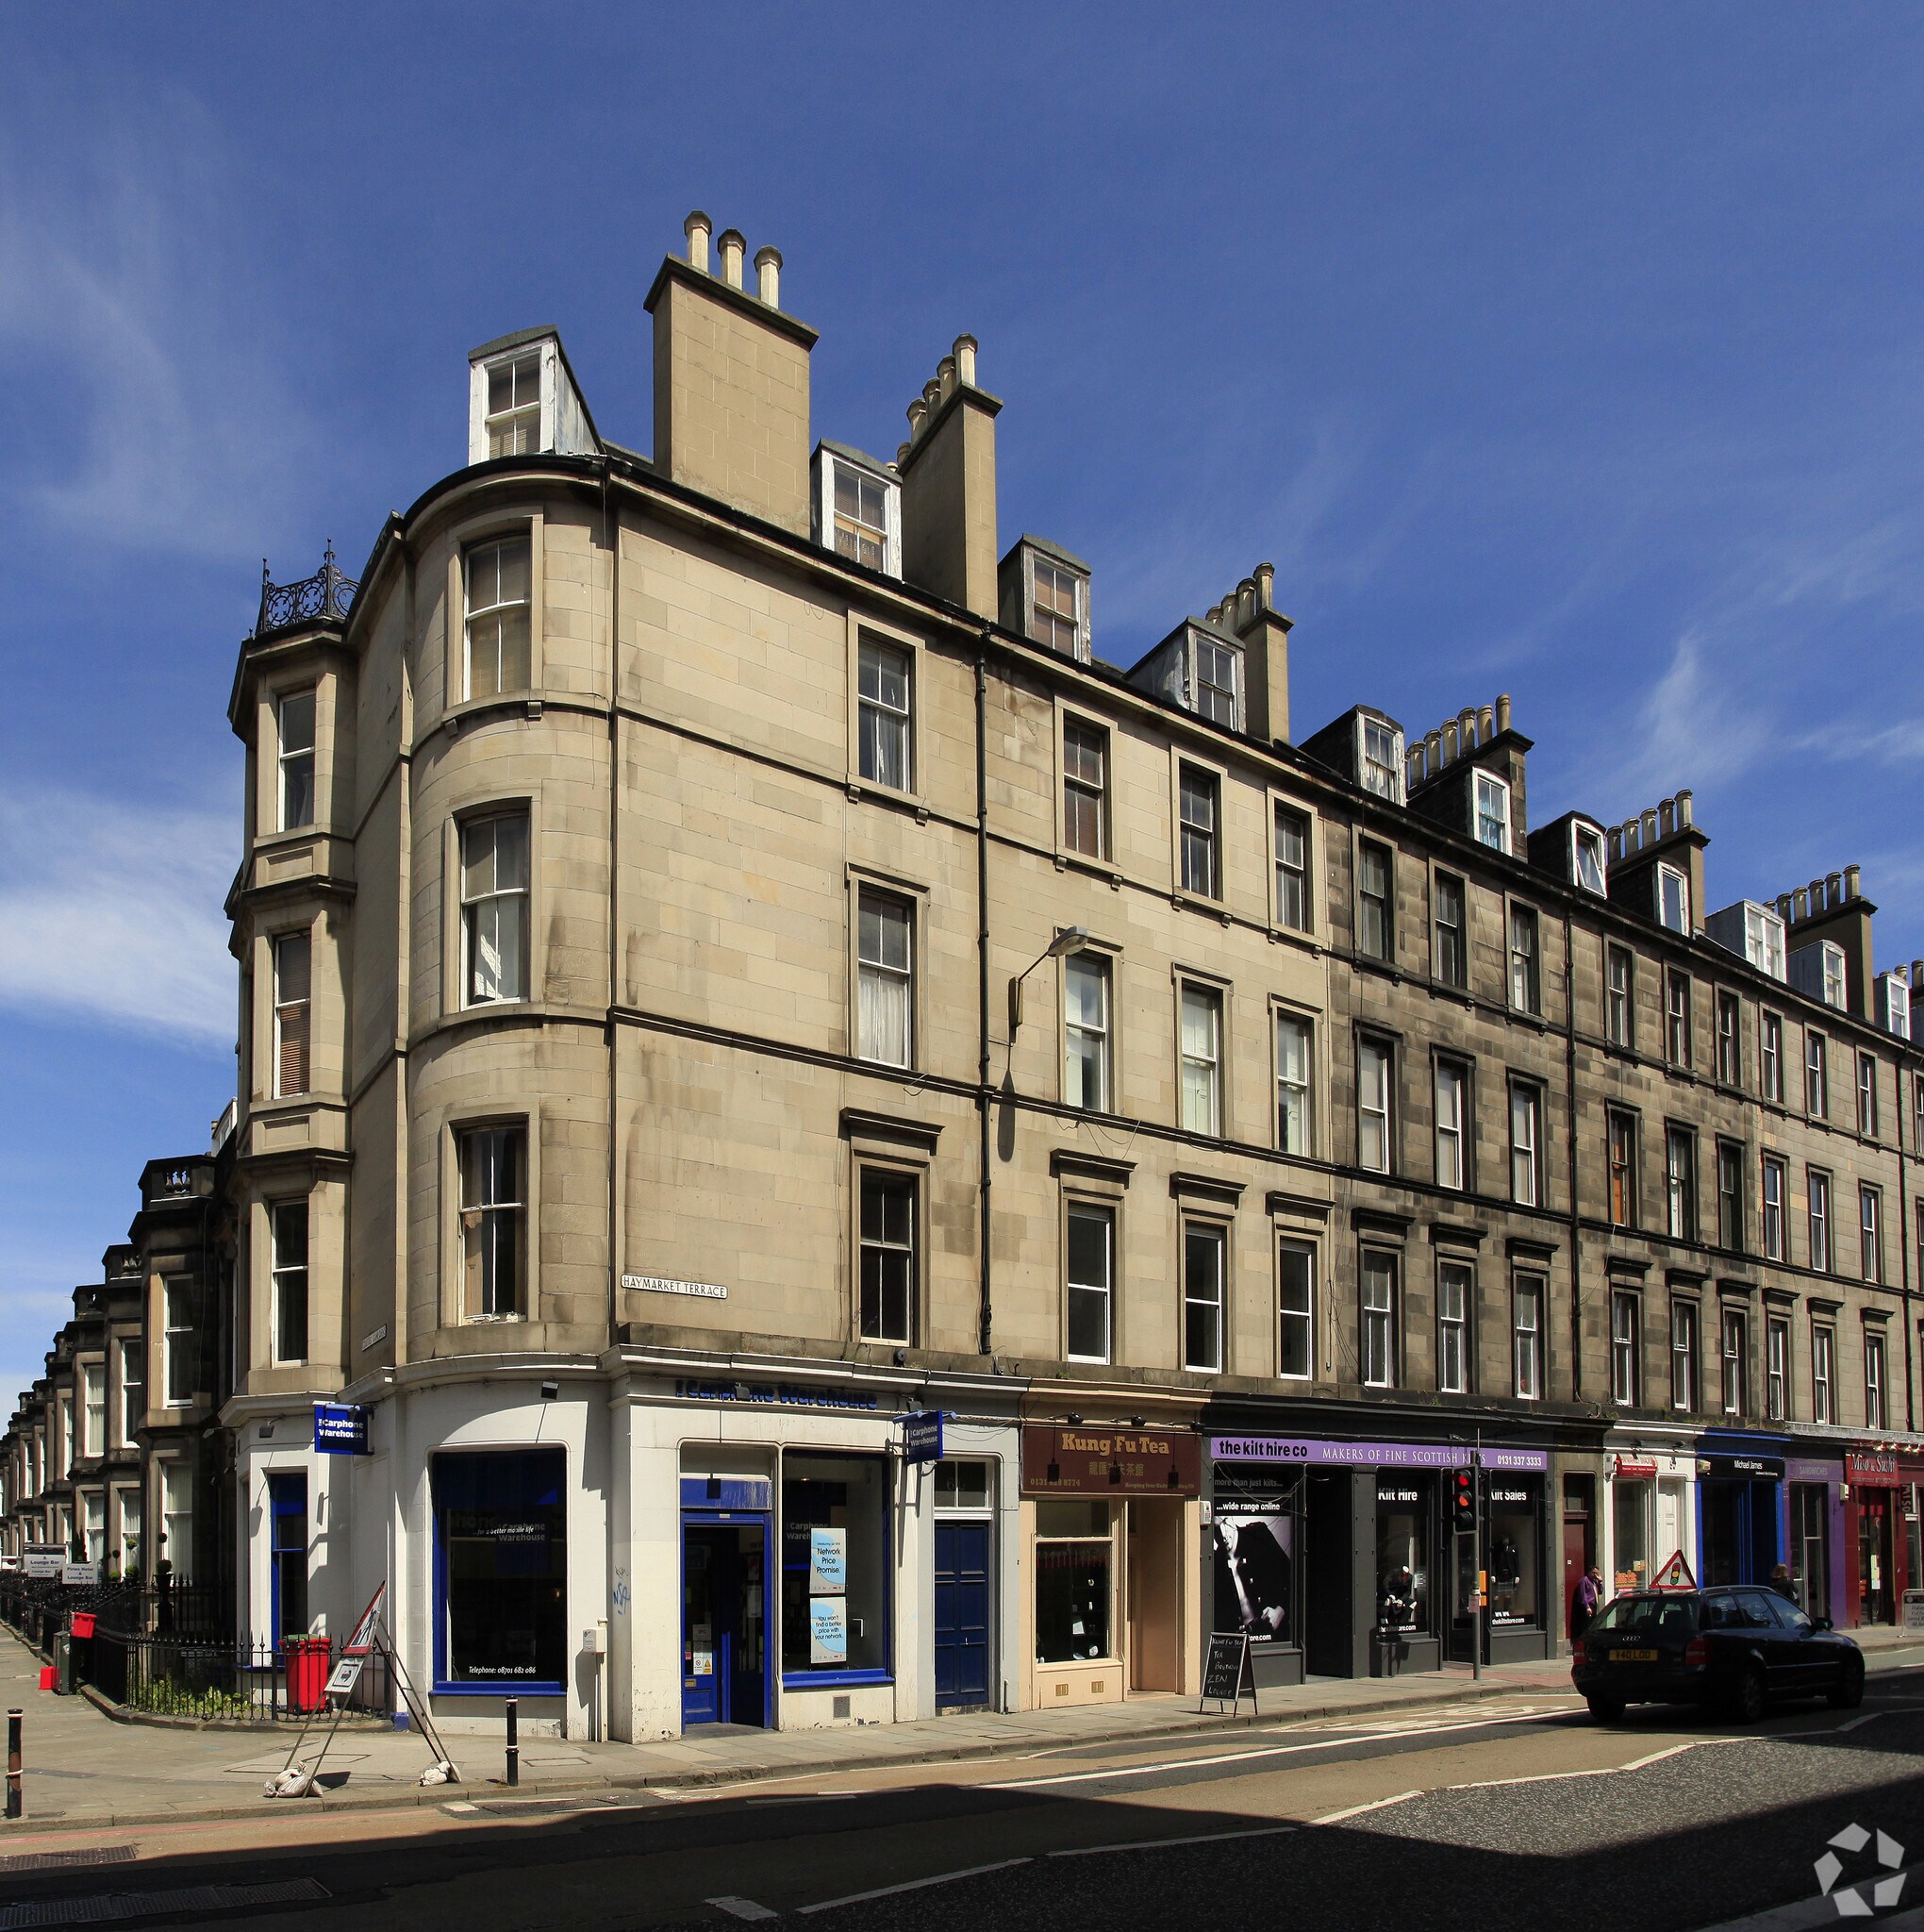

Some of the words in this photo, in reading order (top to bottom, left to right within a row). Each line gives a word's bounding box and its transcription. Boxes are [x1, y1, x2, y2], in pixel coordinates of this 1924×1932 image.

[623, 1276, 681, 1291] HAYMARKET
[684, 1283, 725, 1296] TERRACE
[777, 1384, 877, 1409] Warehouse
[323, 1419, 363, 1428] Carphone
[319, 1429, 363, 1438] Warehouse
[912, 1424, 937, 1437] Carphone
[910, 1436, 937, 1447] Warehouse
[1062, 1433, 1111, 1457] Kung
[1114, 1436, 1136, 1453] Fu
[1138, 1437, 1169, 1454] Tea
[1219, 1441, 1241, 1455] the
[1243, 1440, 1264, 1456] kilt
[1266, 1441, 1290, 1457] hire
[1292, 1445, 1308, 1457] co
[1322, 1447, 1364, 1460] MAKERS
[1368, 1449, 1381, 1460] OF
[1385, 1450, 1407, 1461] FINE
[1412, 1451, 1458, 1463] SCOTTISH
[1497, 1454, 1512, 1465] 0131
[1513, 1456, 1525, 1466] 337
[1526, 1456, 1542, 1466] 3333
[1733, 1459, 1750, 1469] Michael
[1750, 1460, 1763, 1470] James
[1851, 1454, 1869, 1471] Miso
[1876, 1455, 1896, 1473] Sushi
[1030, 1477, 1048, 1486] 0131
[1234, 1477, 1248, 1486] than
[1249, 1478, 1262, 1488] just
[1378, 1488, 1396, 1500] Kilt
[1398, 1488, 1418, 1501] Hire
[1504, 1489, 1527, 1500] Sales
[1902, 1485, 1911, 1512] MISO
[1216, 1502, 1239, 1510] ...wide
[1240, 1503, 1259, 1512] range
[1260, 1502, 1281, 1510] online
[525, 1525, 534, 1534] life
[498, 1533, 545, 1542] Warehouse
[821, 1557, 837, 1565] Price
[1209, 1687, 1232, 1696] LOUNGE
